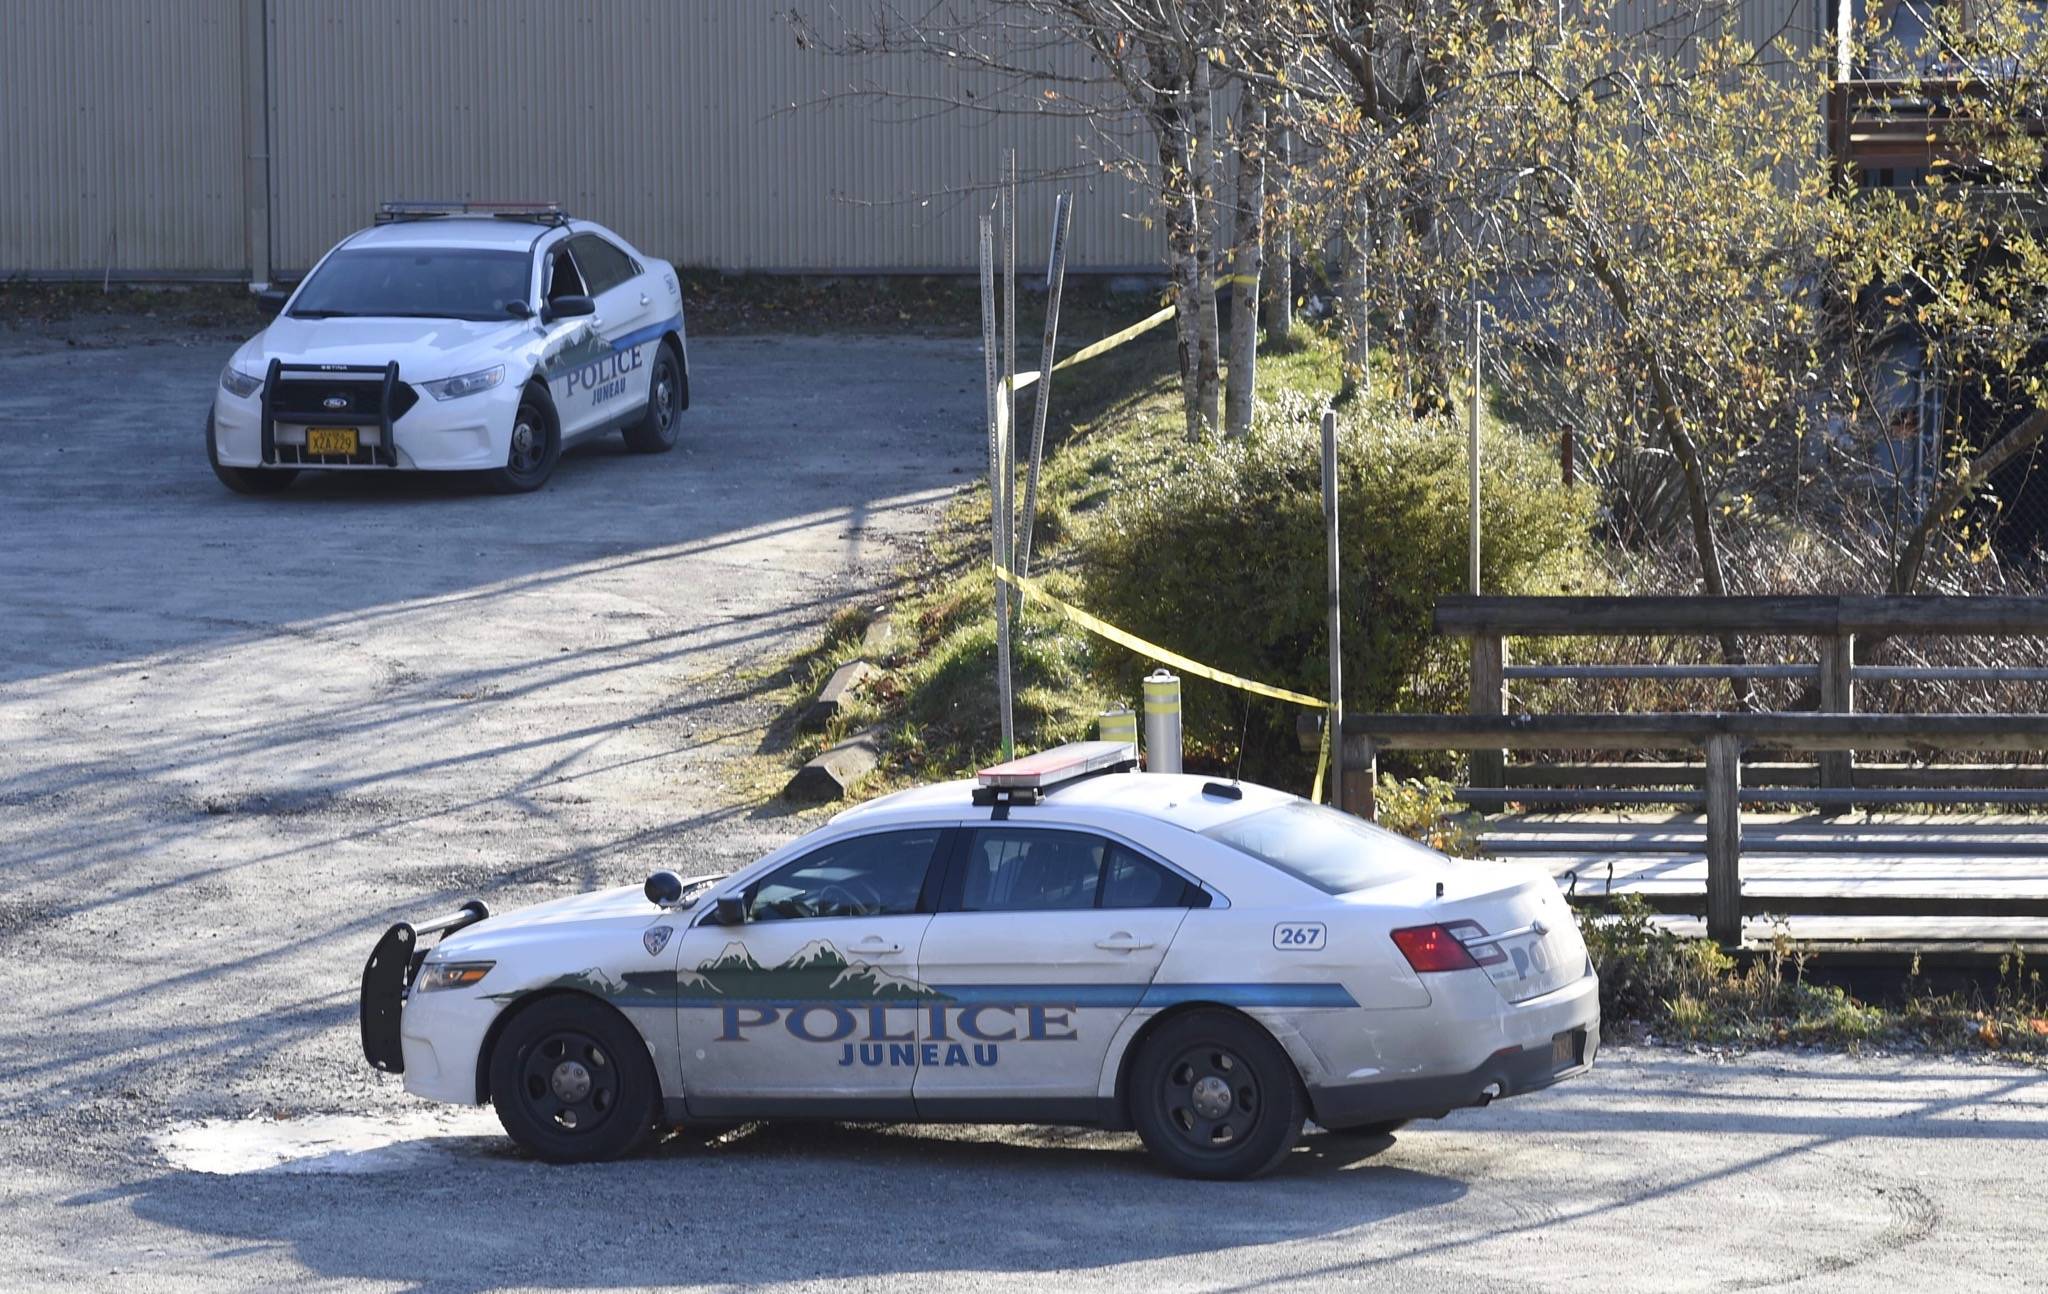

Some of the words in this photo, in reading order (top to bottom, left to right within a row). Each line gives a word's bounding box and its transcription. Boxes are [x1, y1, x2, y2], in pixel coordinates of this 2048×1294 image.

[567, 345, 643, 398] POLICE
[592, 377, 626, 406] JUNEAU
[1281, 928, 1320, 944] 267
[714, 1002, 1078, 1042] POLICE
[838, 1043, 998, 1067] JUNEAU
